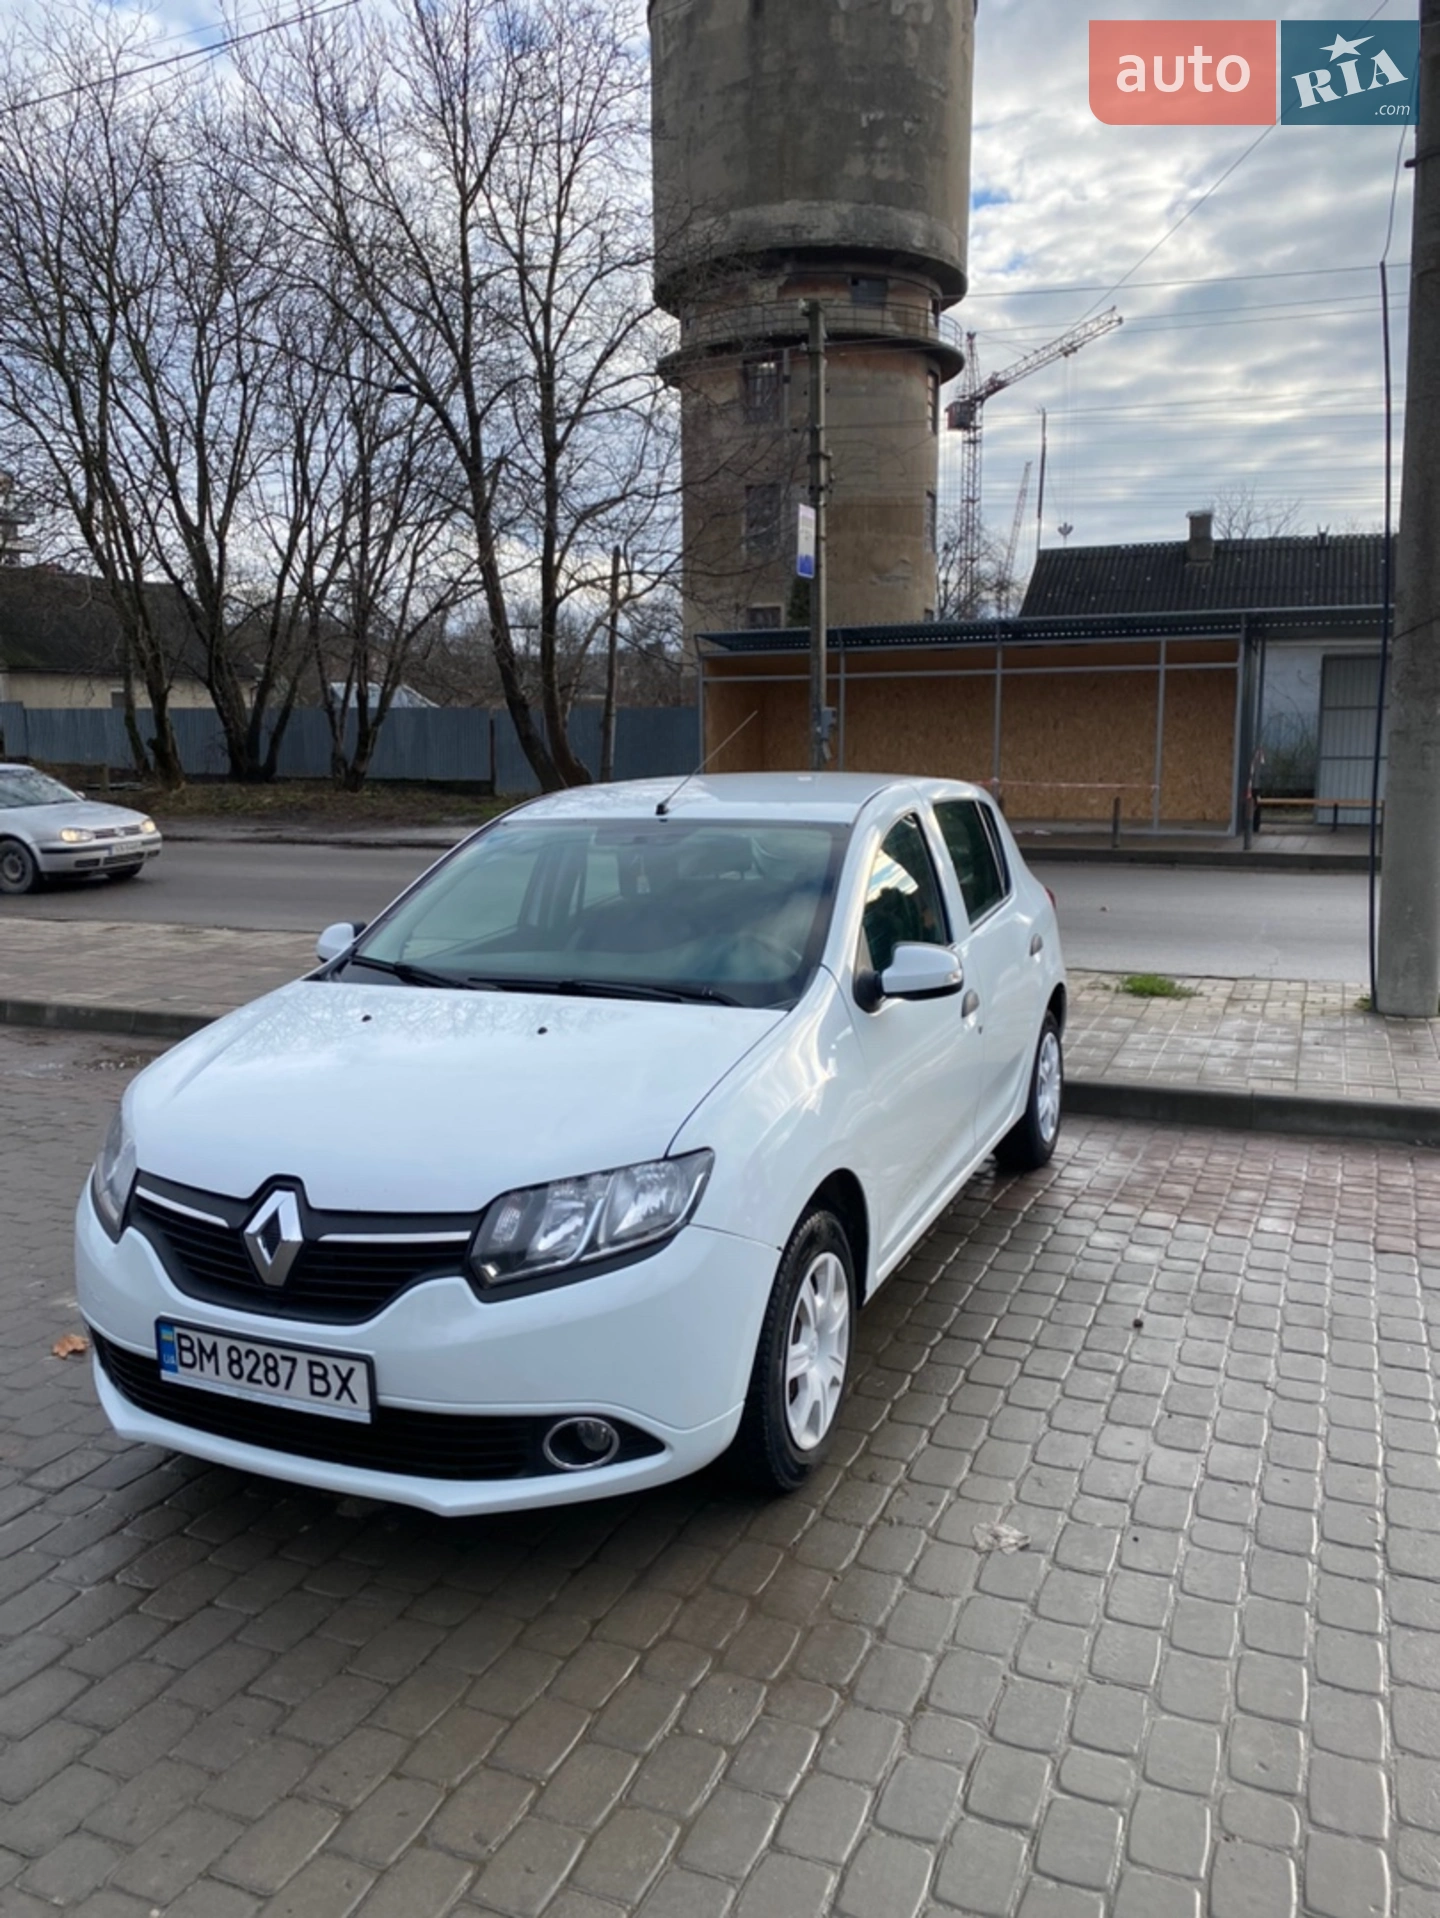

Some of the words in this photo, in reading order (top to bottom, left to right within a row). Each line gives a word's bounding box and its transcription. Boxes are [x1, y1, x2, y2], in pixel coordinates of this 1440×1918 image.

[176, 1333, 220, 1377] BM
[227, 1345, 298, 1391] 8287
[307, 1360, 357, 1405] BX
